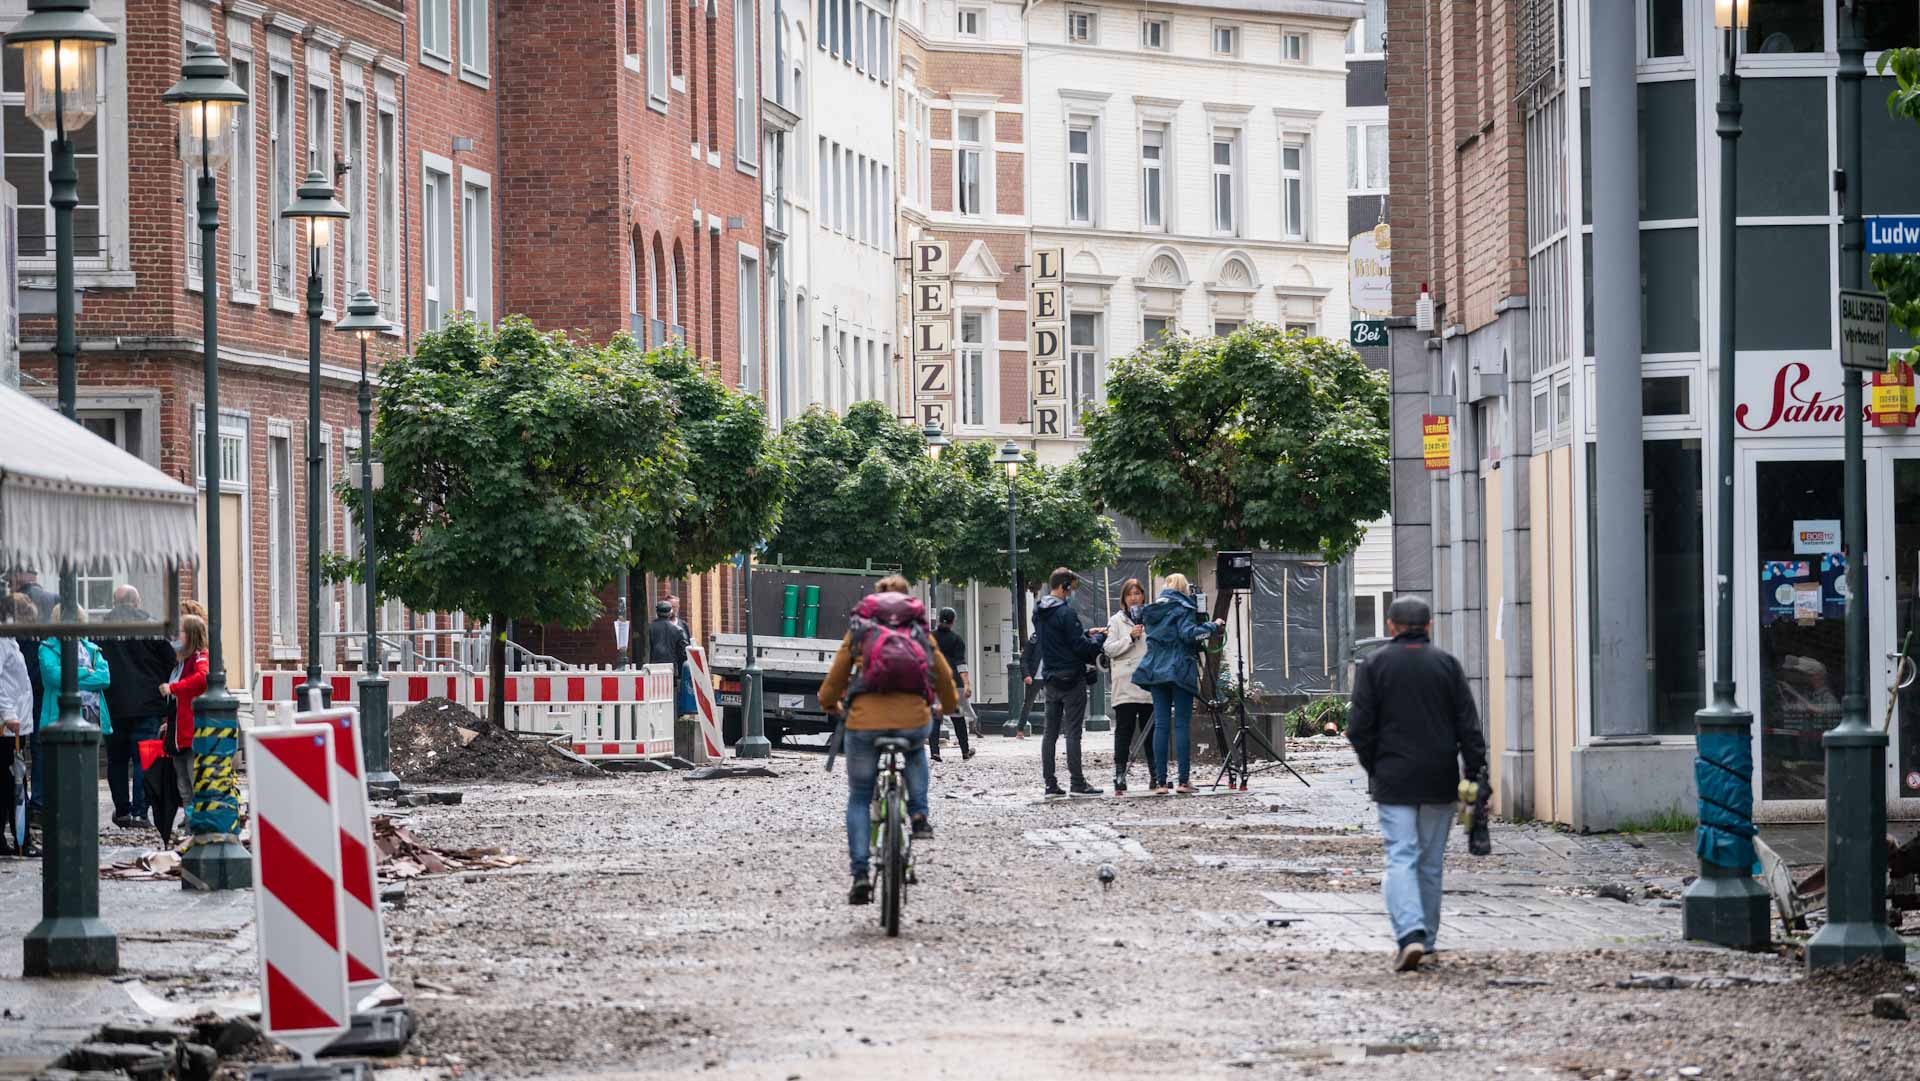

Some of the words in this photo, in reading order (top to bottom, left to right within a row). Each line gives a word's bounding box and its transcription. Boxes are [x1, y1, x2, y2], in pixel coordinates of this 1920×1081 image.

[1871, 221, 1920, 244] Ludw
[1842, 298, 1885, 324] BALLSPIELEN
[917, 245, 946, 432] PELZE
[1035, 252, 1059, 435] LEDER
[1353, 322, 1381, 343] Bei
